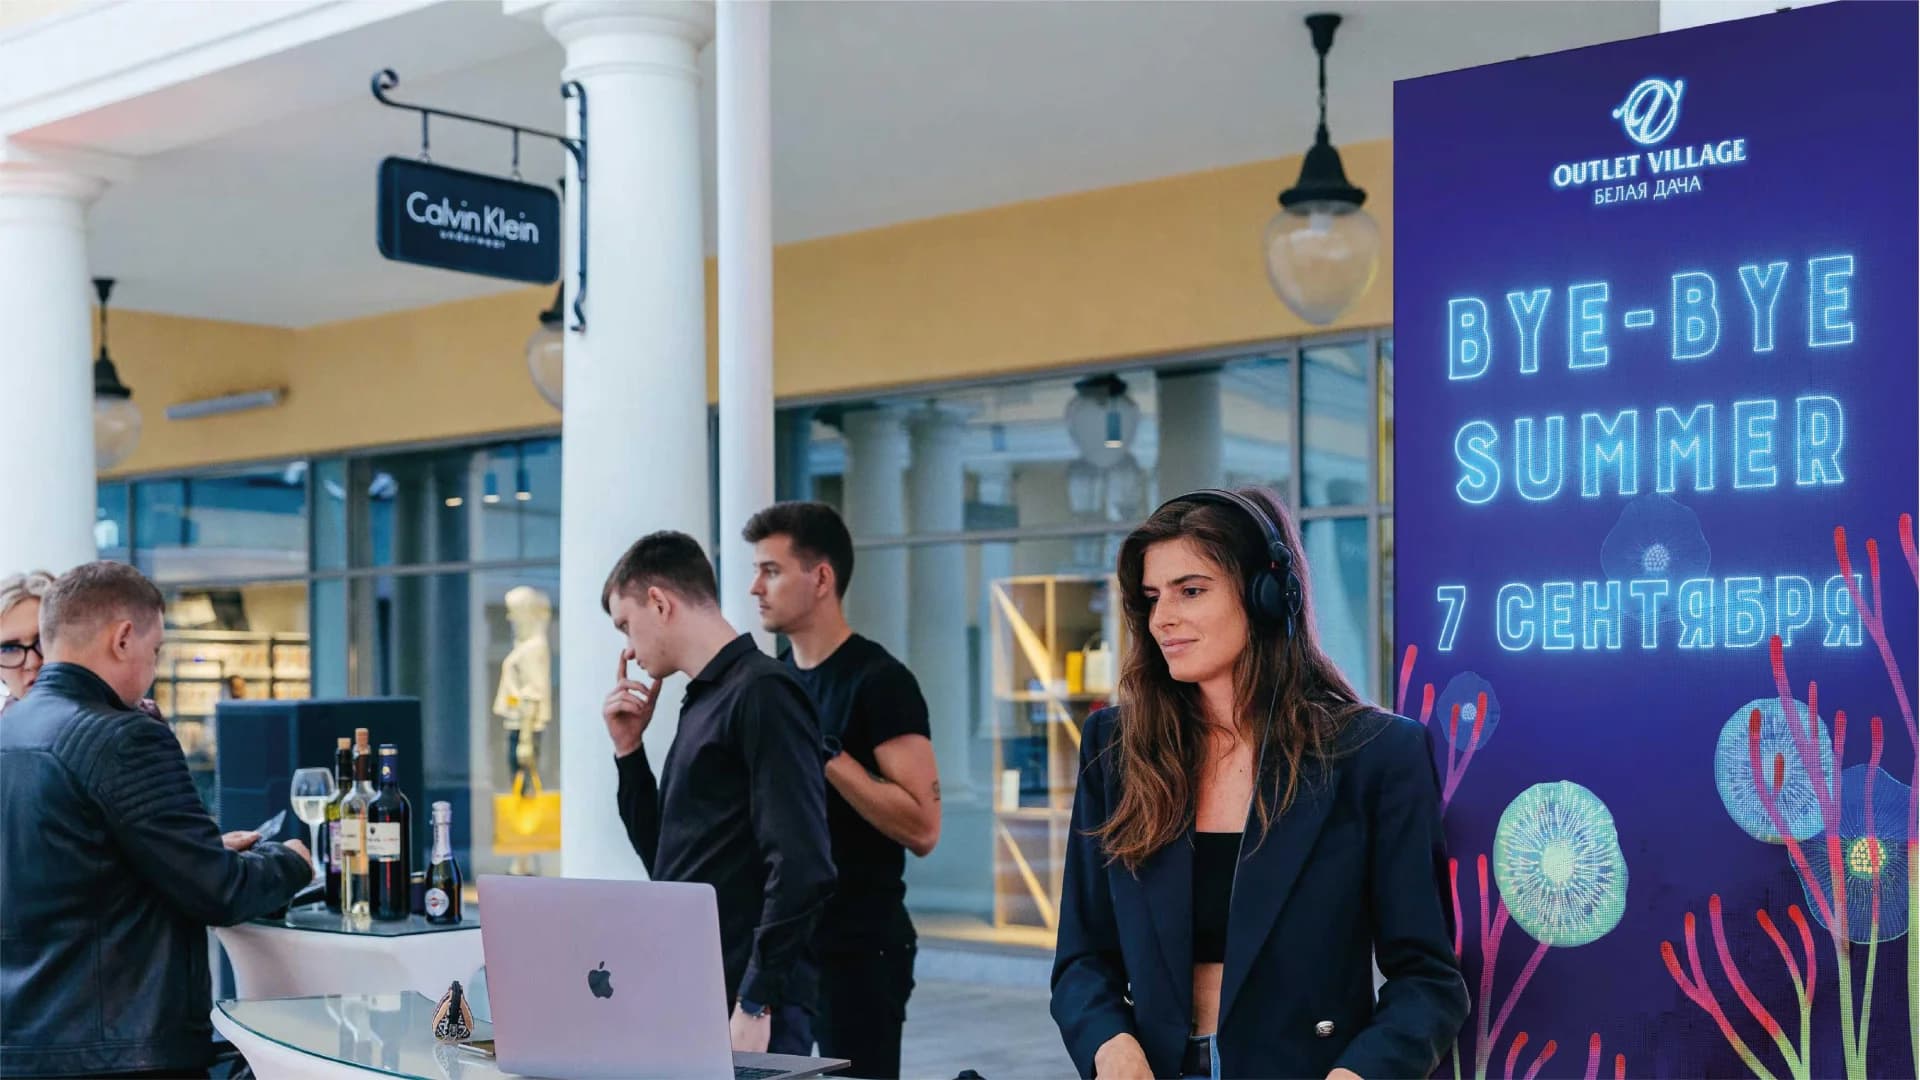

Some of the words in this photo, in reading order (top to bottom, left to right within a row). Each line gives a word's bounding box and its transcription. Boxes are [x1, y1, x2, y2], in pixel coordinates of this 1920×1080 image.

[1553, 154, 1640, 187] OUTLET
[1647, 139, 1746, 173] VILLAGE
[1594, 181, 1648, 205] БЕЛАЯ
[1653, 175, 1702, 201] ДАЧА
[406, 191, 480, 233] Calvin
[484, 204, 539, 244] Klein
[1448, 255, 1854, 380] BYE-BYE
[1455, 395, 1844, 504] SUMMER
[1436, 585, 1467, 651] 7
[1496, 574, 1864, 651] СЕНТЯБРЯ
